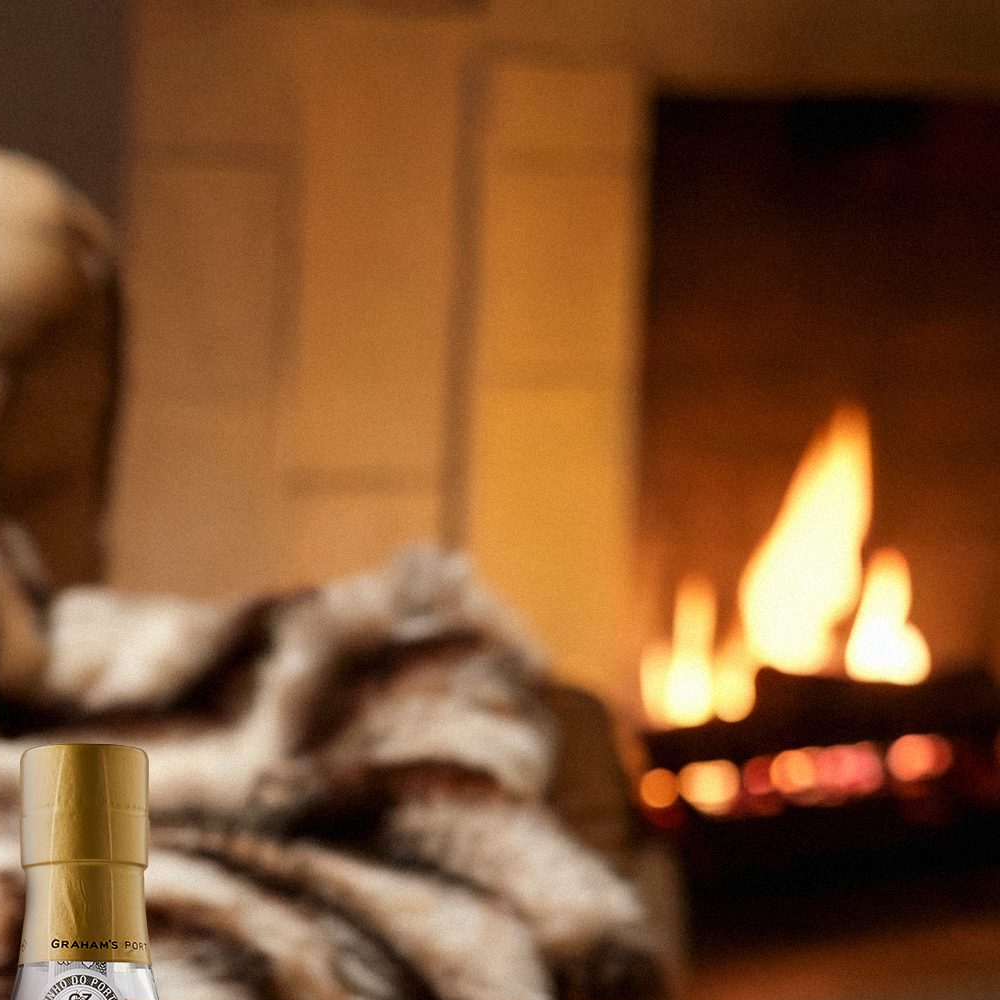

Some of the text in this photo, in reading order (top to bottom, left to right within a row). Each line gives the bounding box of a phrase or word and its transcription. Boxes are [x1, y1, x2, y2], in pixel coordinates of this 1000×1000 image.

[51, 939, 147, 951] GRAHAM'S PORT
[72, 974, 87, 985] DO
